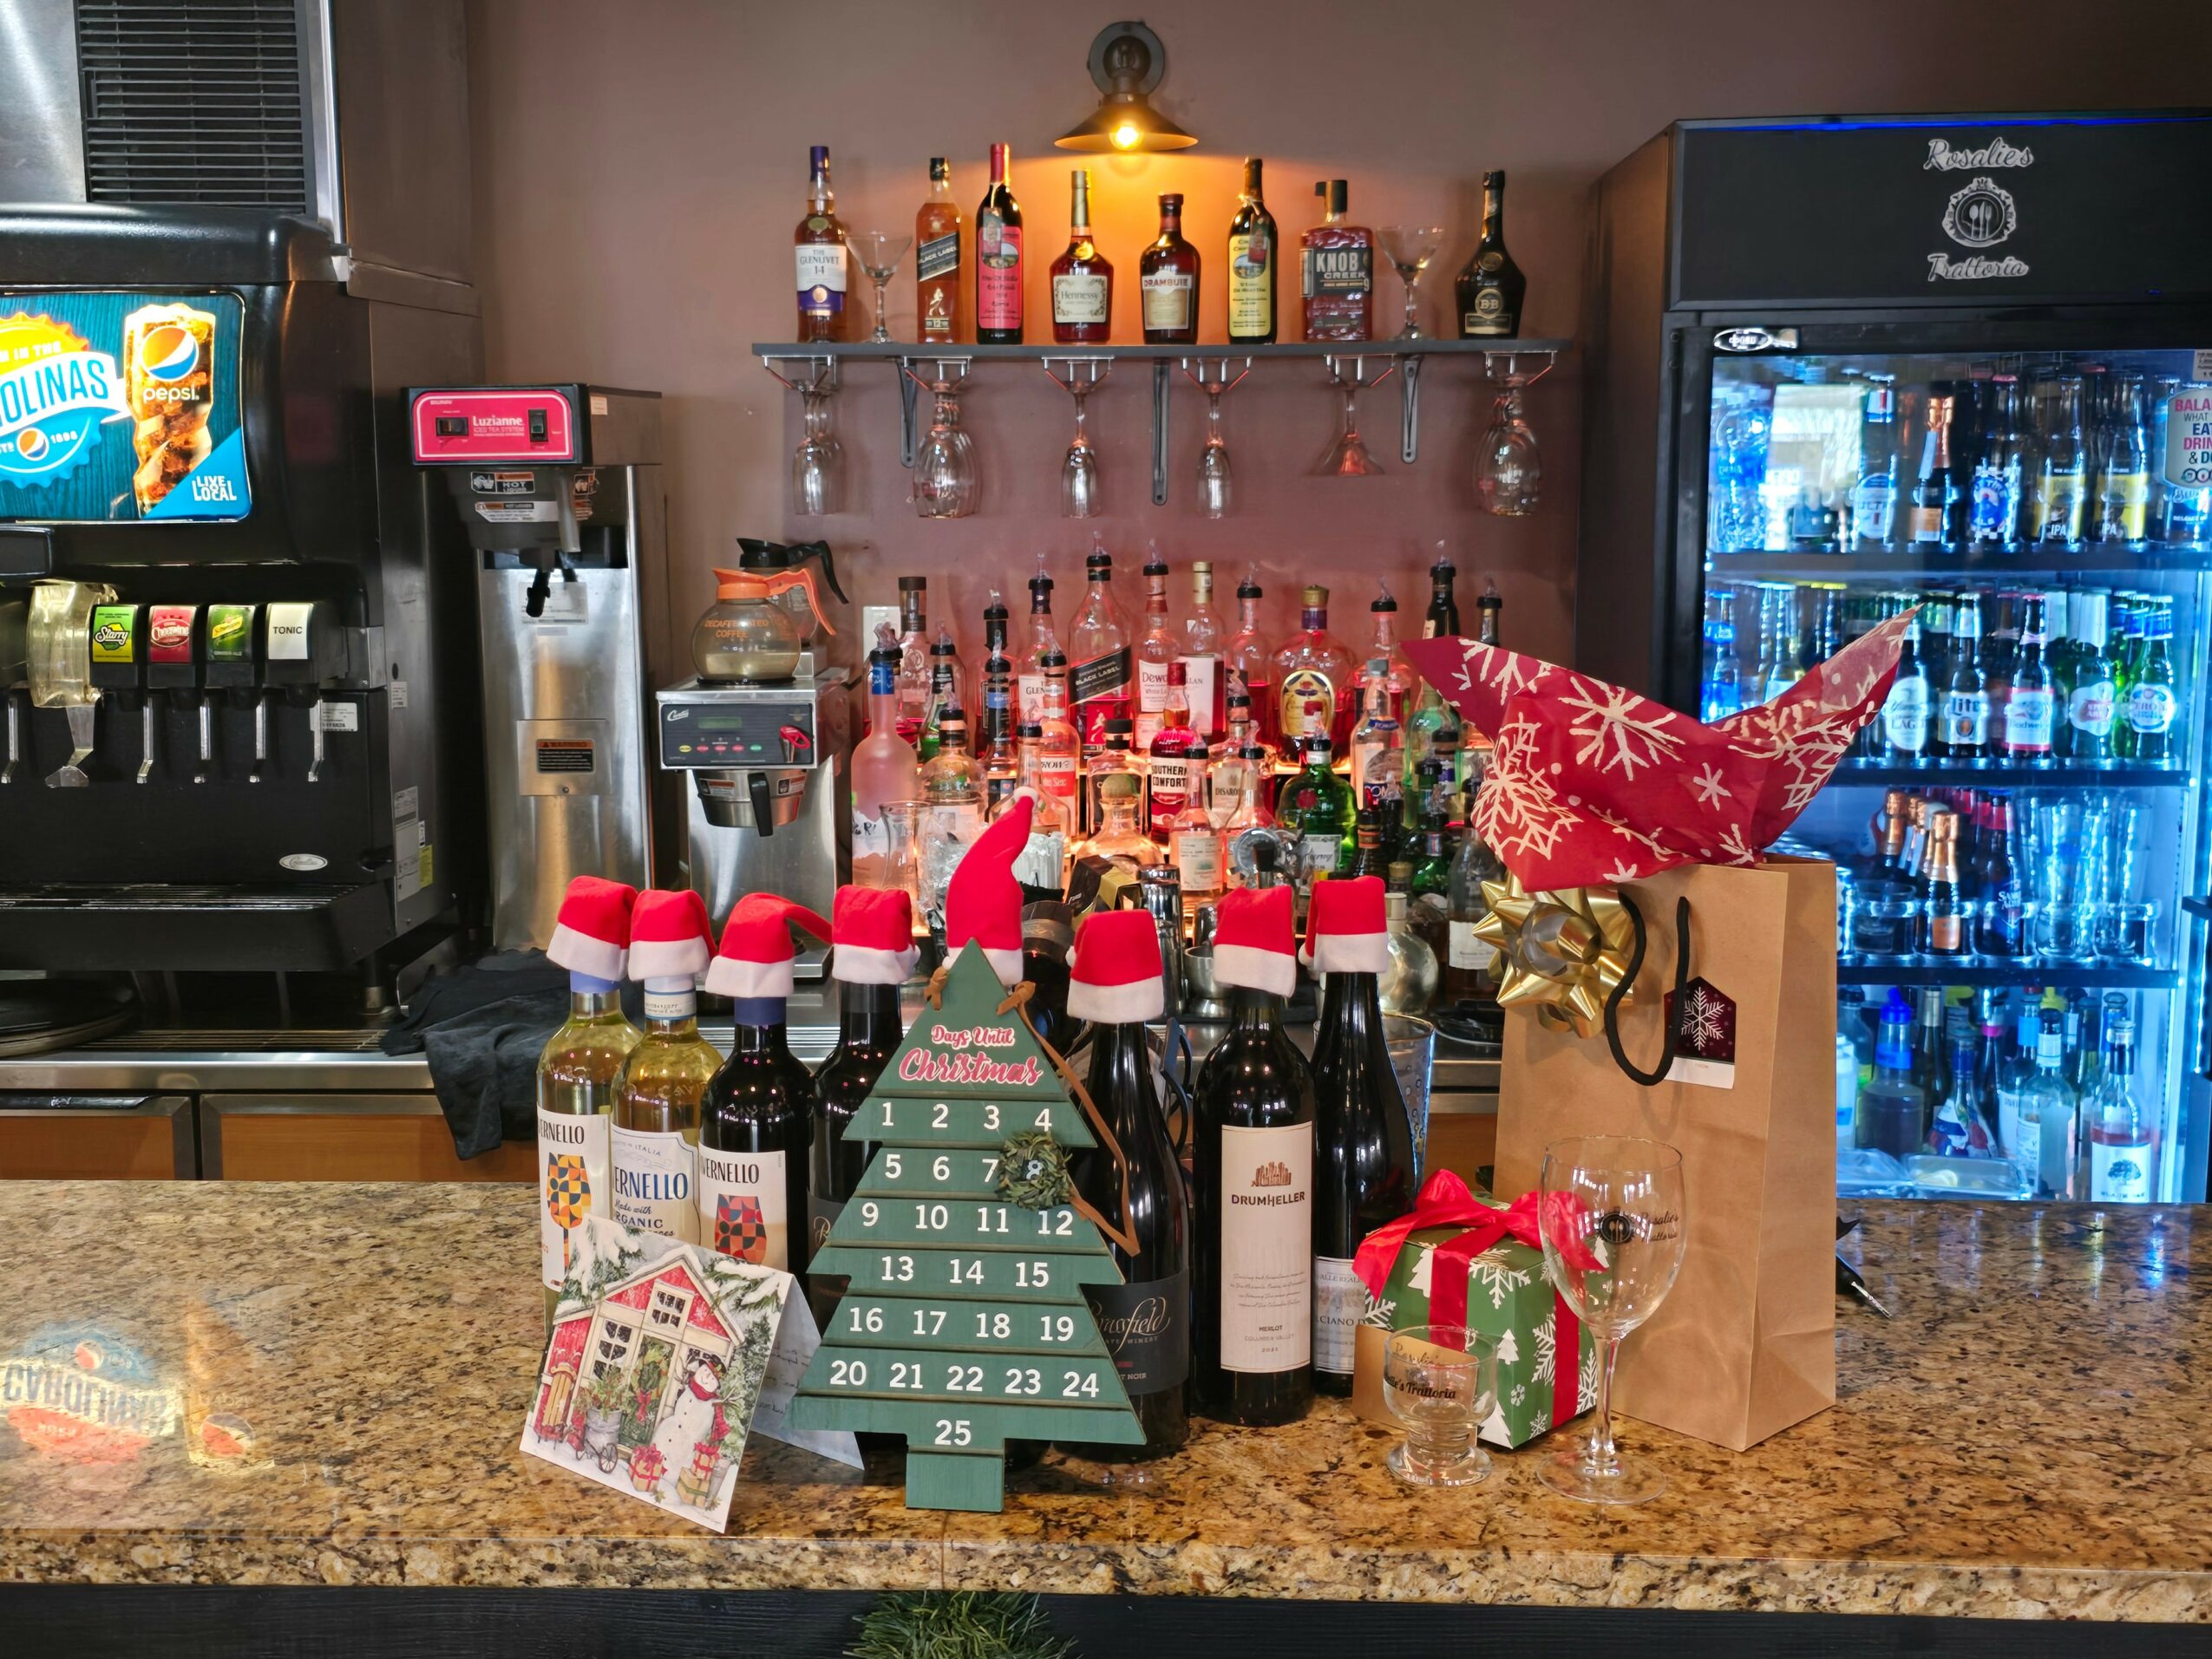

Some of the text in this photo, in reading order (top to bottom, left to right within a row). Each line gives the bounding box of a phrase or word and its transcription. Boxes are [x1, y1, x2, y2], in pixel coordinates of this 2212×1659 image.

[799, 256, 840, 265] GLENLIVET
[1316, 251, 1359, 273] KNOB
[1927, 251, 2030, 282] Trattoria
[1143, 278, 1189, 288] DRAMBUIE
[1364, 278, 1370, 291] 9
[1060, 291, 1098, 302] Hennessy
[31, 340, 62, 357] THE
[142, 387, 197, 405] pepsi
[472, 414, 524, 427] Luzianne
[2183, 412, 2209, 422] WHAT
[2192, 422, 2212, 436] EA
[2188, 452, 2199, 465] &
[196, 475, 226, 488] LIVE
[192, 480, 237, 502] LOCAL
[2051, 524, 2067, 536] IPA
[95, 625, 129, 646] Starry
[272, 625, 304, 635] TONIC
[715, 630, 750, 638] COFFEE
[1075, 666, 1120, 686] BLACK LABEL
[1952, 697, 1980, 716] Lite
[1152, 776, 1187, 788] COMFORT
[931, 1023, 1016, 1049] Days Until
[899, 1048, 1044, 1086] Christmas
[881, 1101, 1052, 1133] 1 2 3 4
[885, 1153, 1042, 1183] 5 6 7 8
[1231, 1190, 1306, 1208] DRUMHELLER
[633, 1205, 652, 1215] with
[861, 1202, 1074, 1236] 9 10 11 12
[880, 1256, 1050, 1288] 13 14 15
[849, 1307, 1074, 1342] 16 17 18 19
[1127, 1336, 1158, 1345] WINERY
[829, 1360, 1099, 1398] 20 21 22 23 24
[1127, 1372, 1147, 1381] NOIR
[1406, 1381, 1456, 1399] Trattoria
[934, 1420, 972, 1447] 25
